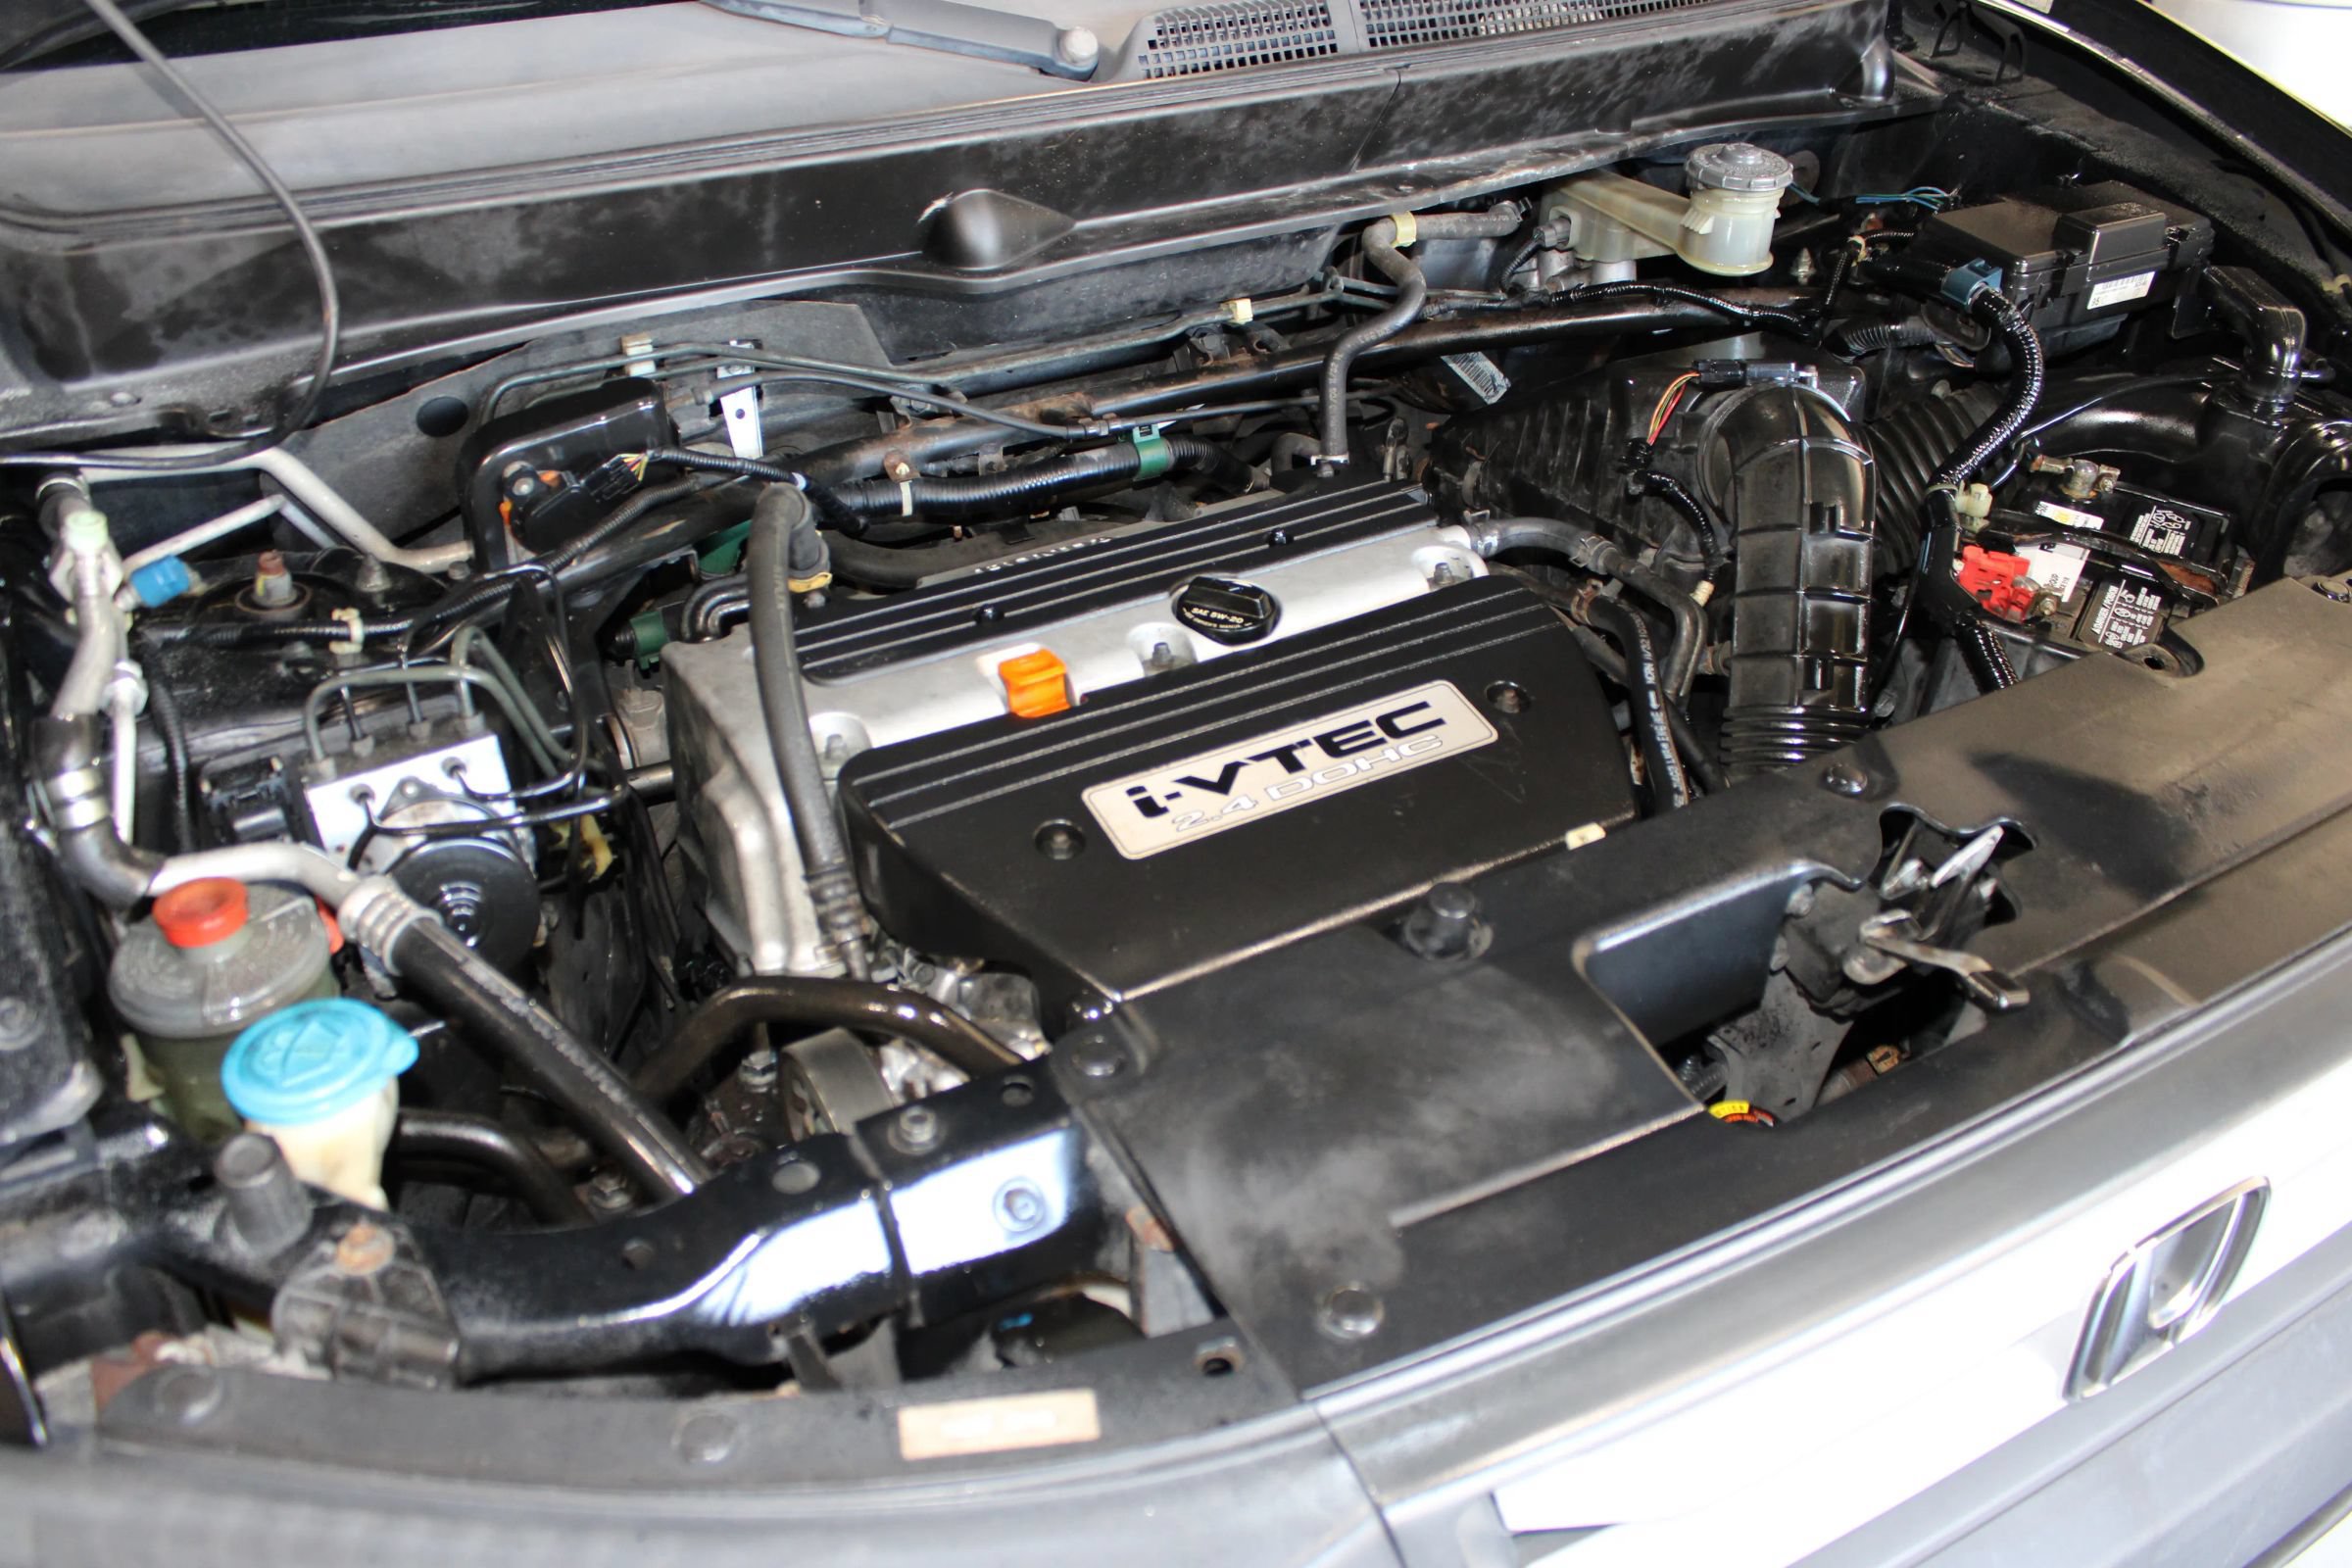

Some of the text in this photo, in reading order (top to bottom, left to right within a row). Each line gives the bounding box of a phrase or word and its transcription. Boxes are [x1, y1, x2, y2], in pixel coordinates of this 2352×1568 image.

[1125, 701, 1447, 818] i-VTEC
[1171, 735, 1444, 832] 2.4 DOHC
